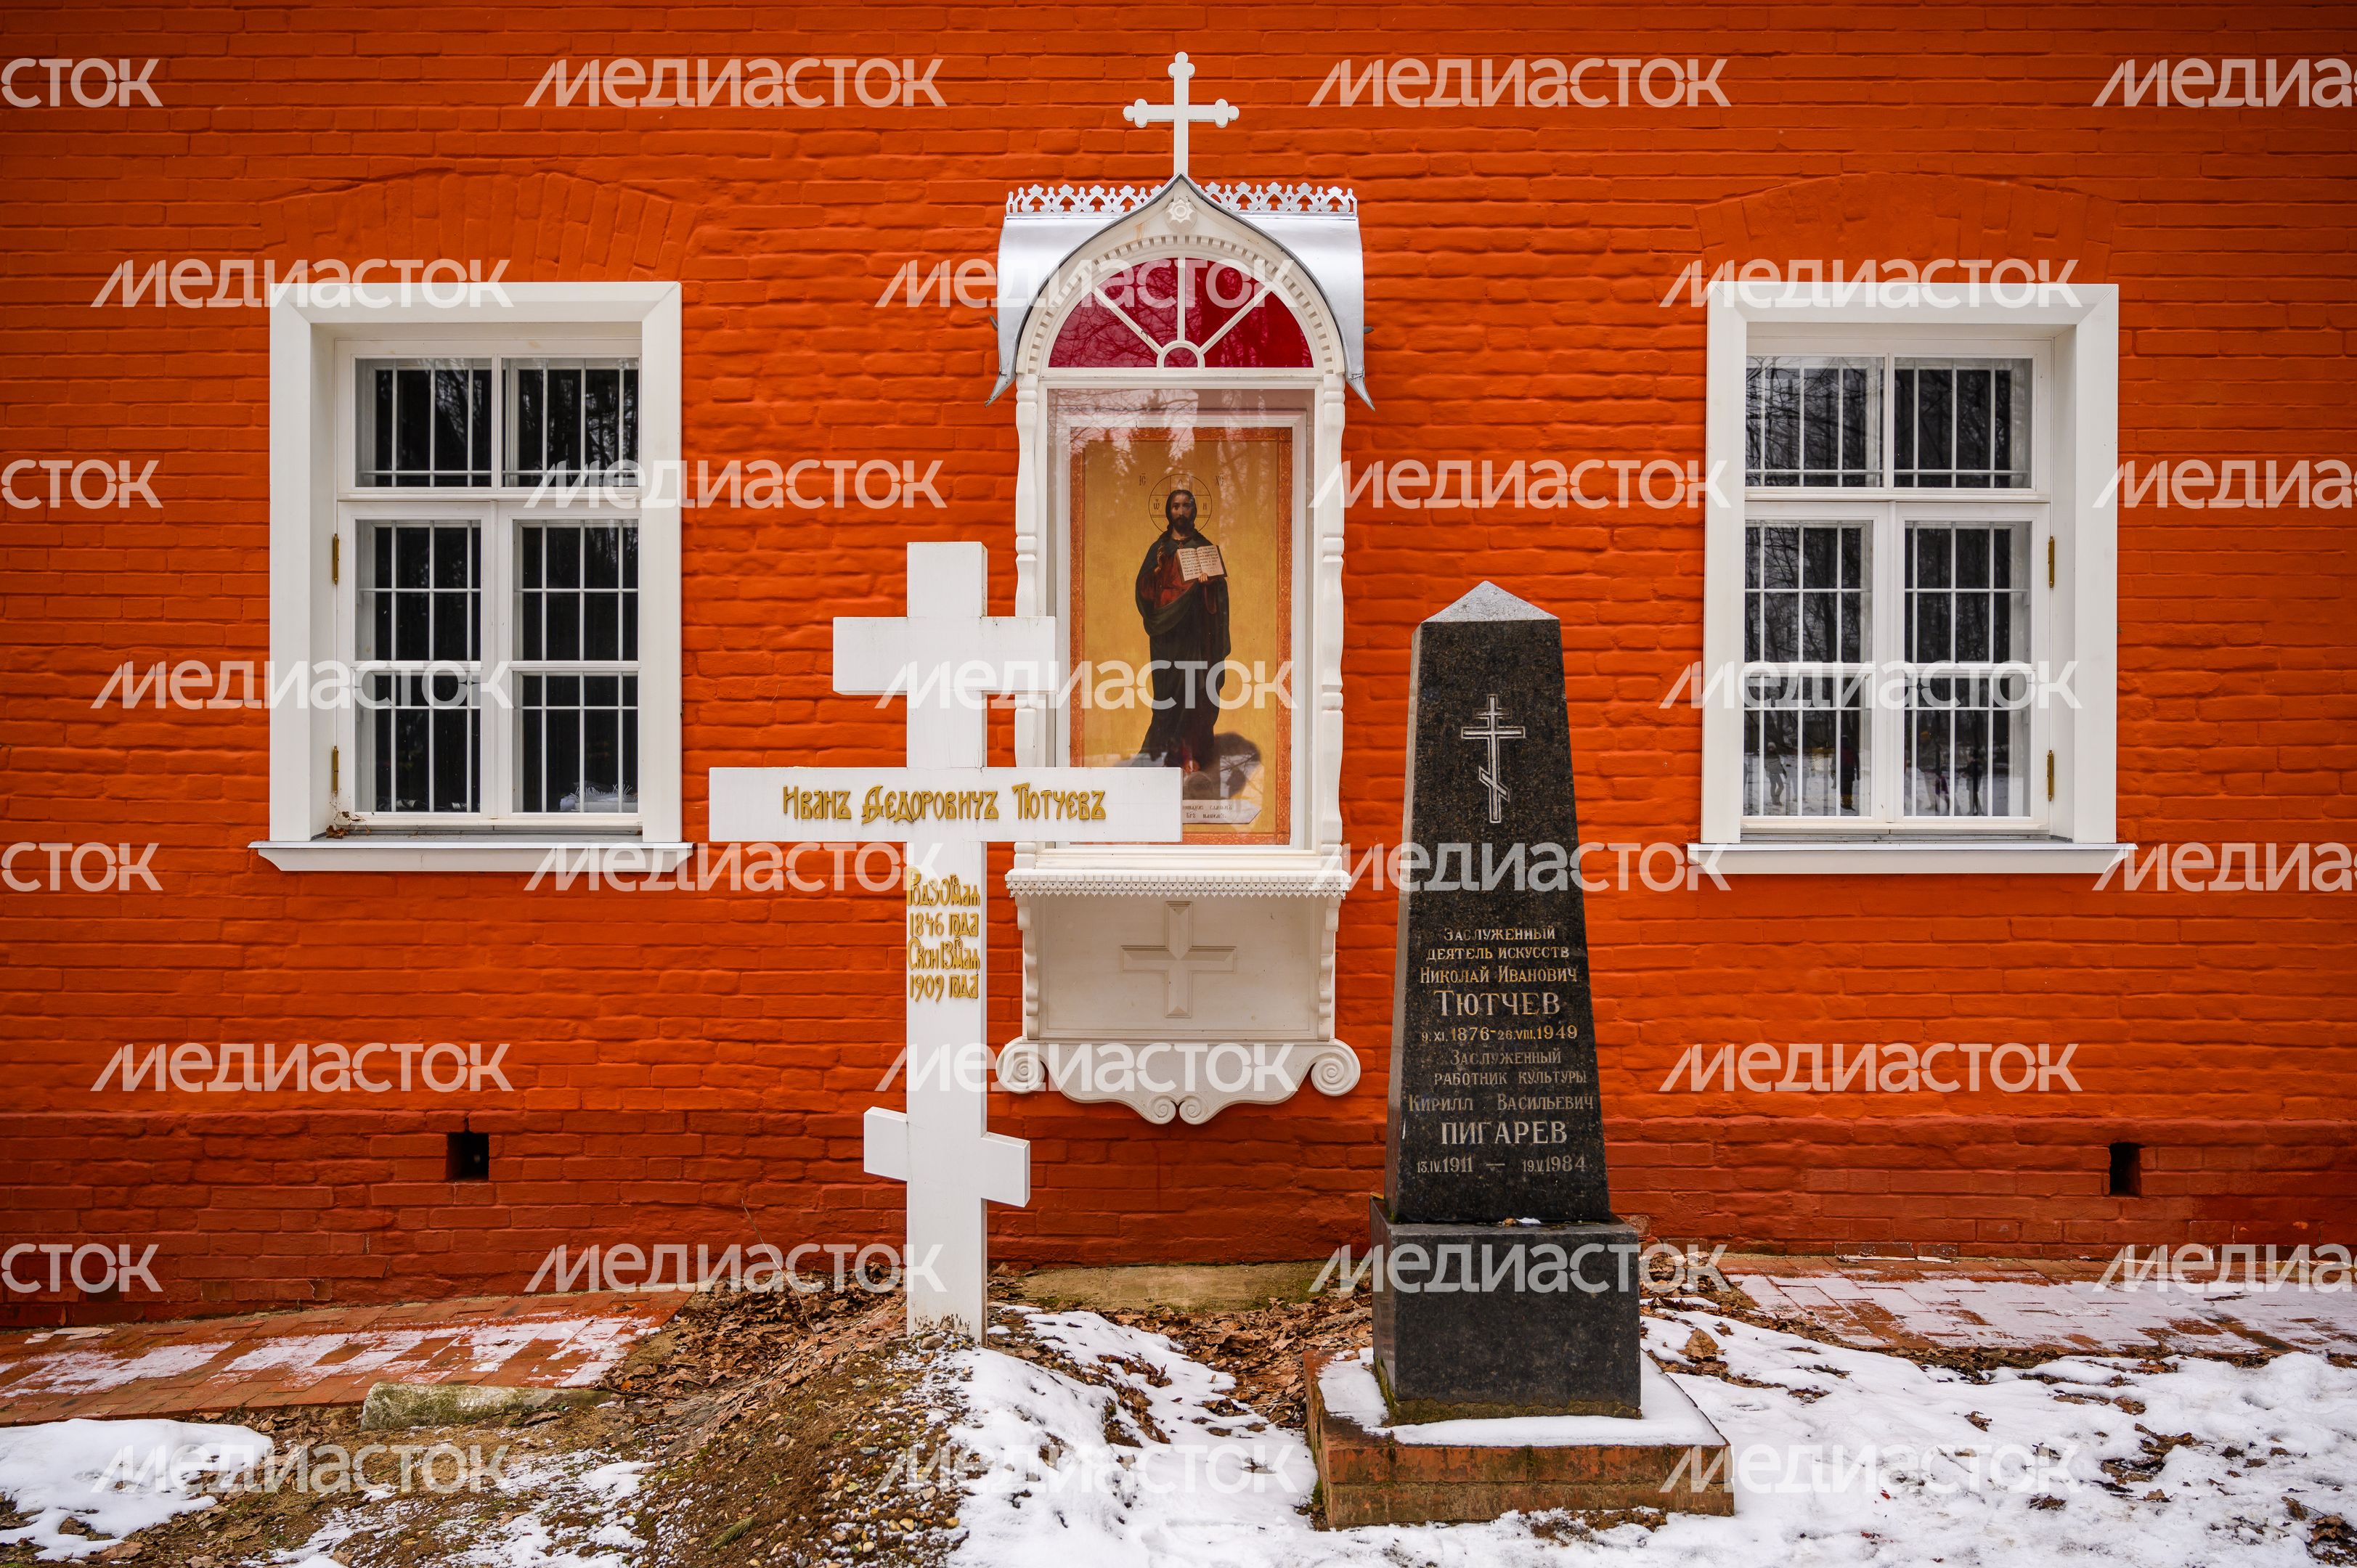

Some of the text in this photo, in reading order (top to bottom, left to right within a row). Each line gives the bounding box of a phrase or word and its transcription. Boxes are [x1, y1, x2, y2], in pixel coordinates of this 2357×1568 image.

[909, 912, 945, 936] 1846
[909, 974, 945, 1003] 1909
[1433, 989, 1560, 1016] ТЮТЧЕВ
[1441, 1120, 1568, 1145] ПИГАРЕВ
